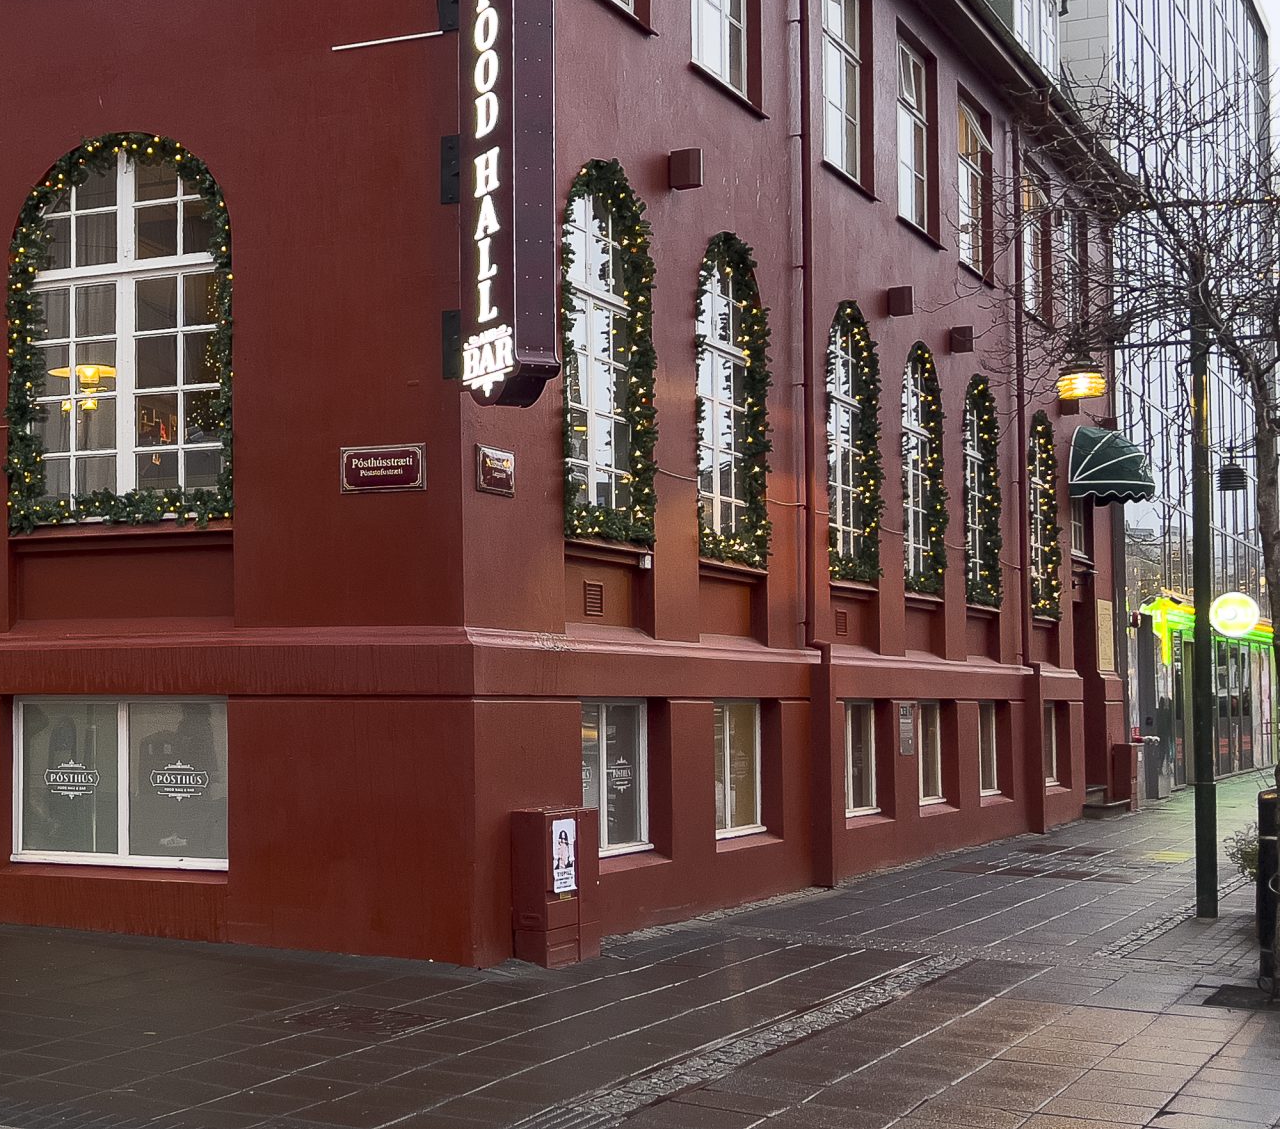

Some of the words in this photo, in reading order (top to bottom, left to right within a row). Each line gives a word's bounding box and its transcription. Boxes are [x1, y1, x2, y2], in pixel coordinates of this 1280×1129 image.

[473, 145, 501, 324] HALL
[462, 335, 514, 381] BAR
[351, 455, 413, 469] Pósthússtræti
[50, 772, 94, 783] PÓSTHÚS
[156, 773, 202, 784] PÓSTHÚS
